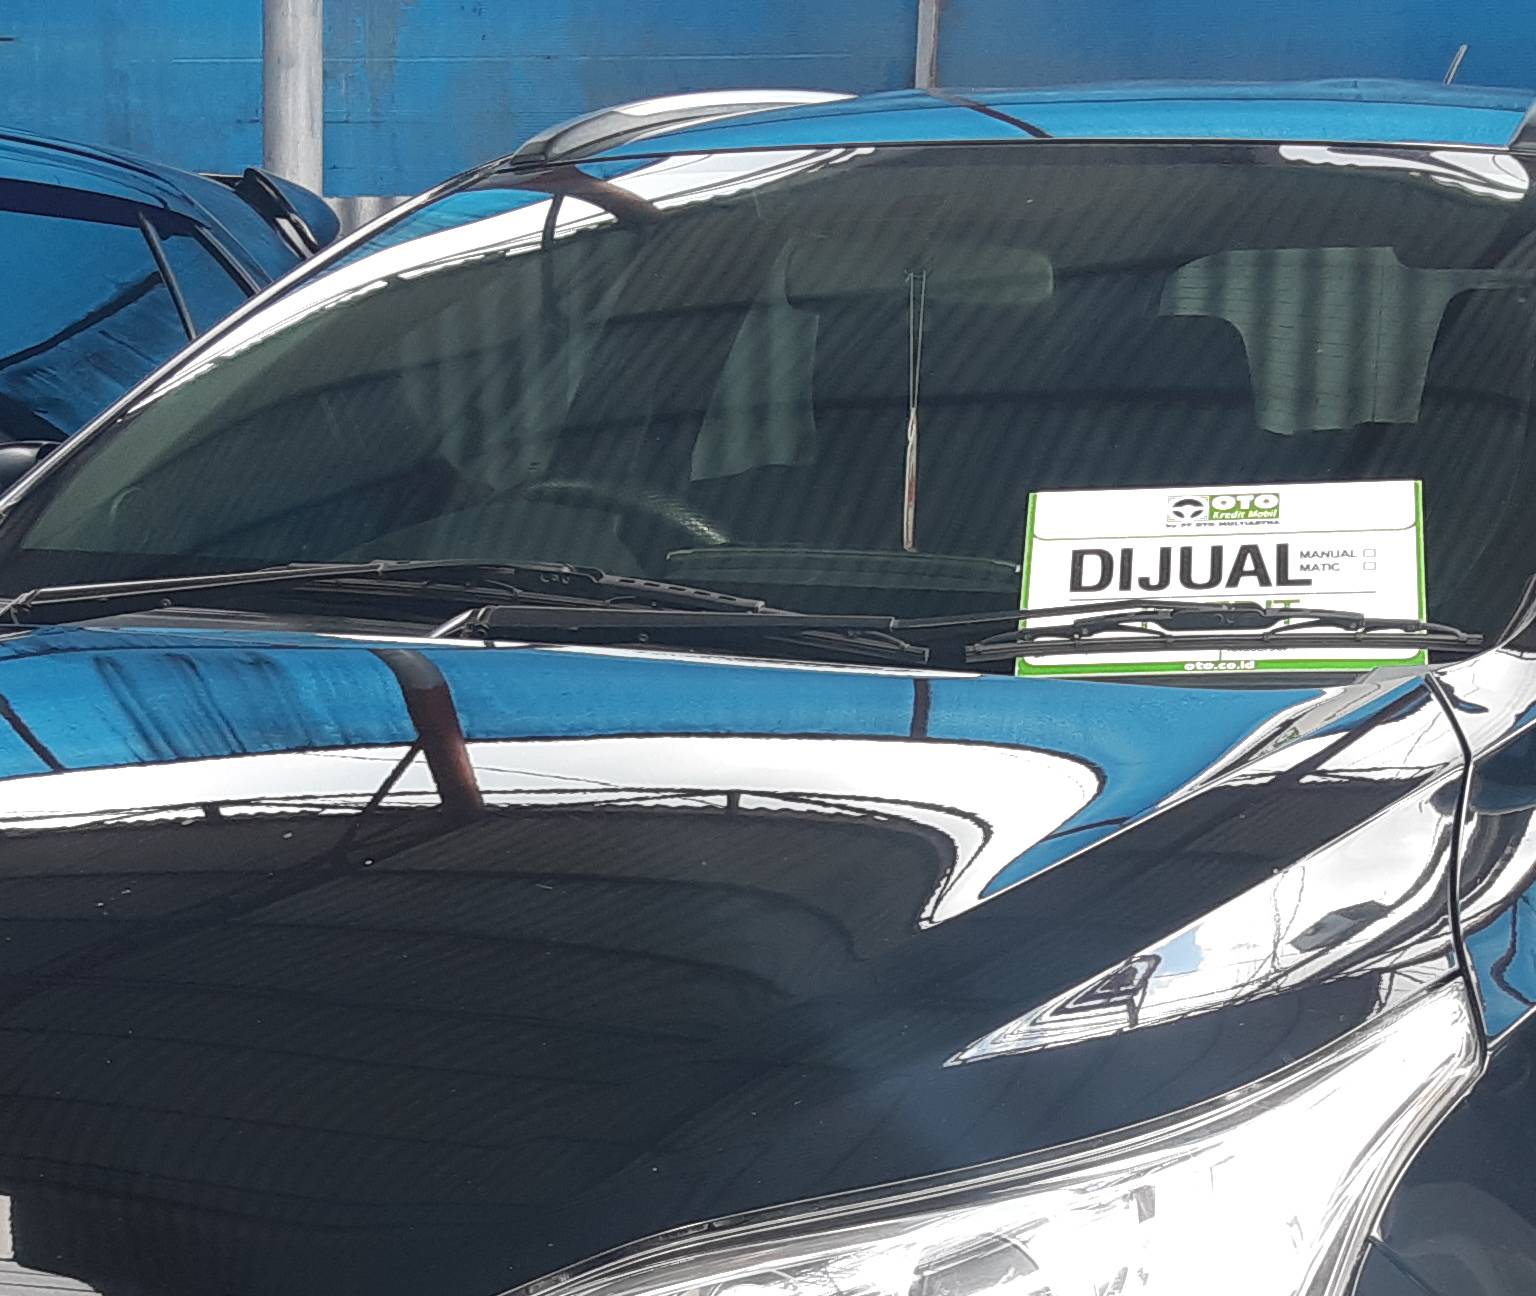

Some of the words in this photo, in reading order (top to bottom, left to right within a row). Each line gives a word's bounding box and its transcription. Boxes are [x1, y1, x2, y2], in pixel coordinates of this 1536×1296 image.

[1211, 493, 1280, 511] OTO
[1212, 510, 1246, 520] Kredit
[1247, 509, 1278, 519] Mobil
[1299, 549, 1358, 559] MANUAL
[1068, 543, 1313, 593] DIJUAL
[1299, 562, 1340, 572] MATIC
[1183, 660, 1256, 672] oto.co.id
